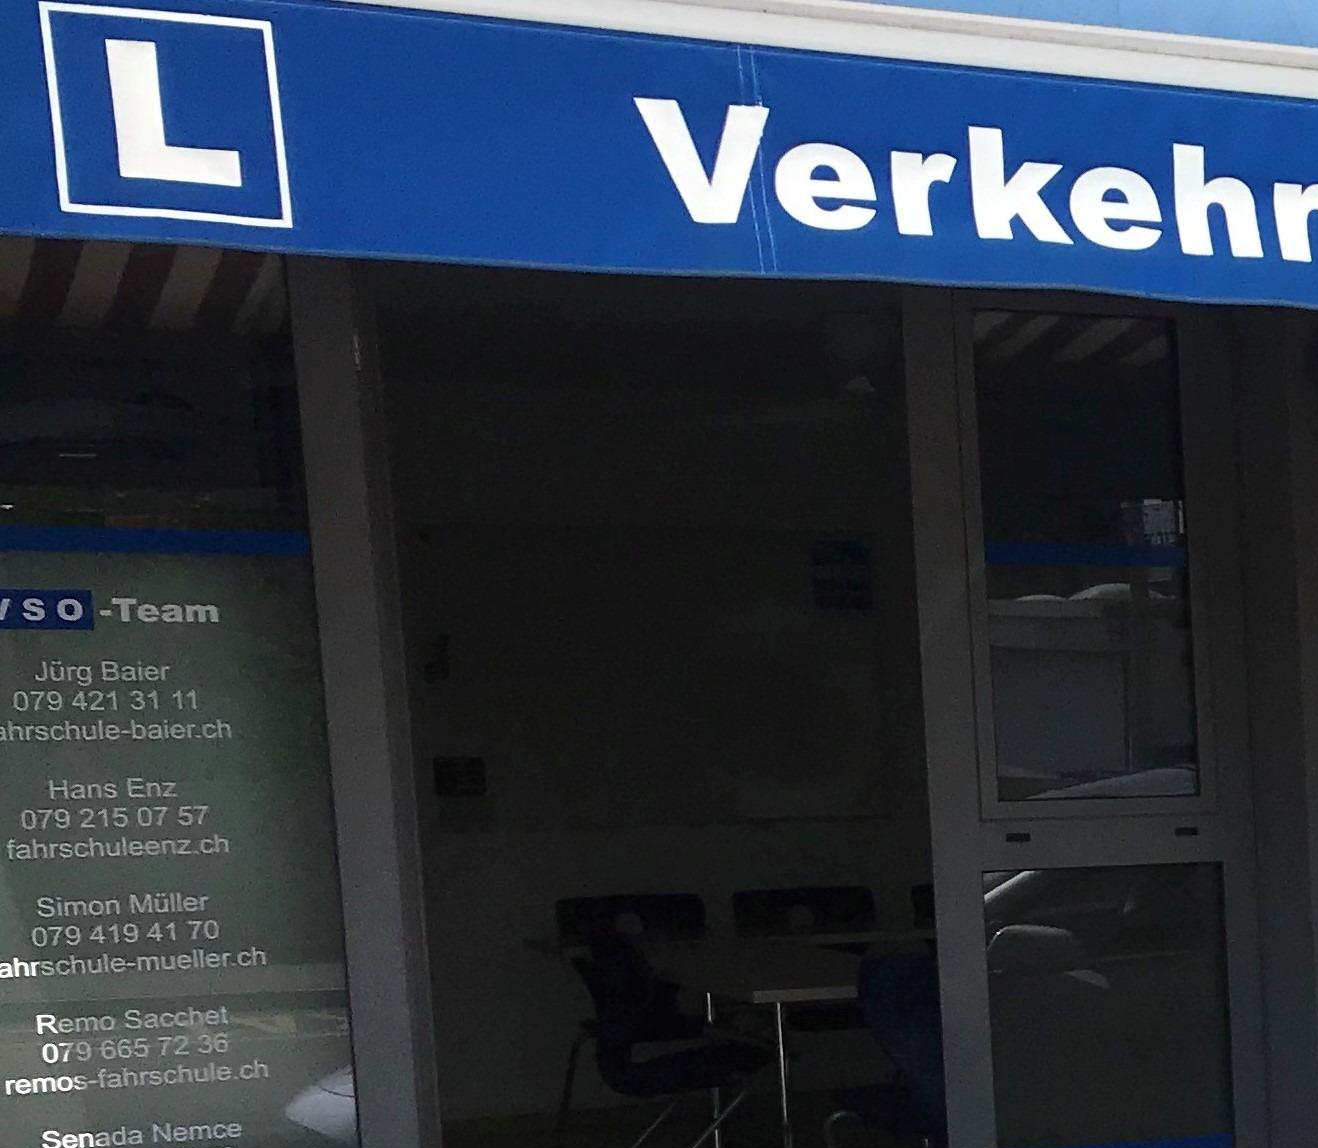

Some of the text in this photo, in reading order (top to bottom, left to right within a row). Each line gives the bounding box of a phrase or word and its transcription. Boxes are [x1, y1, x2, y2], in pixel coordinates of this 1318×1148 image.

[104, 38, 242, 188] L
[100, 598, 220, 623] -Team
[34, 660, 171, 686] Jürg Baier
[13, 688, 200, 712] 079 421 31 11
[49, 777, 179, 800] Hans Enz
[20, 805, 209, 830] 079 215 07 57
[6, 834, 231, 860] fahrschuleenz.ch
[36, 892, 210, 918] Simon Müller
[31, 919, 220, 948] 079 419 41 70
[36, 1005, 230, 1035] Remo Sacchet
[41, 1032, 230, 1065] 079 665 72 36
[5, 1060, 270, 1096] remos-fahrschule.ch
[151, 1121, 243, 1144] Nemce
